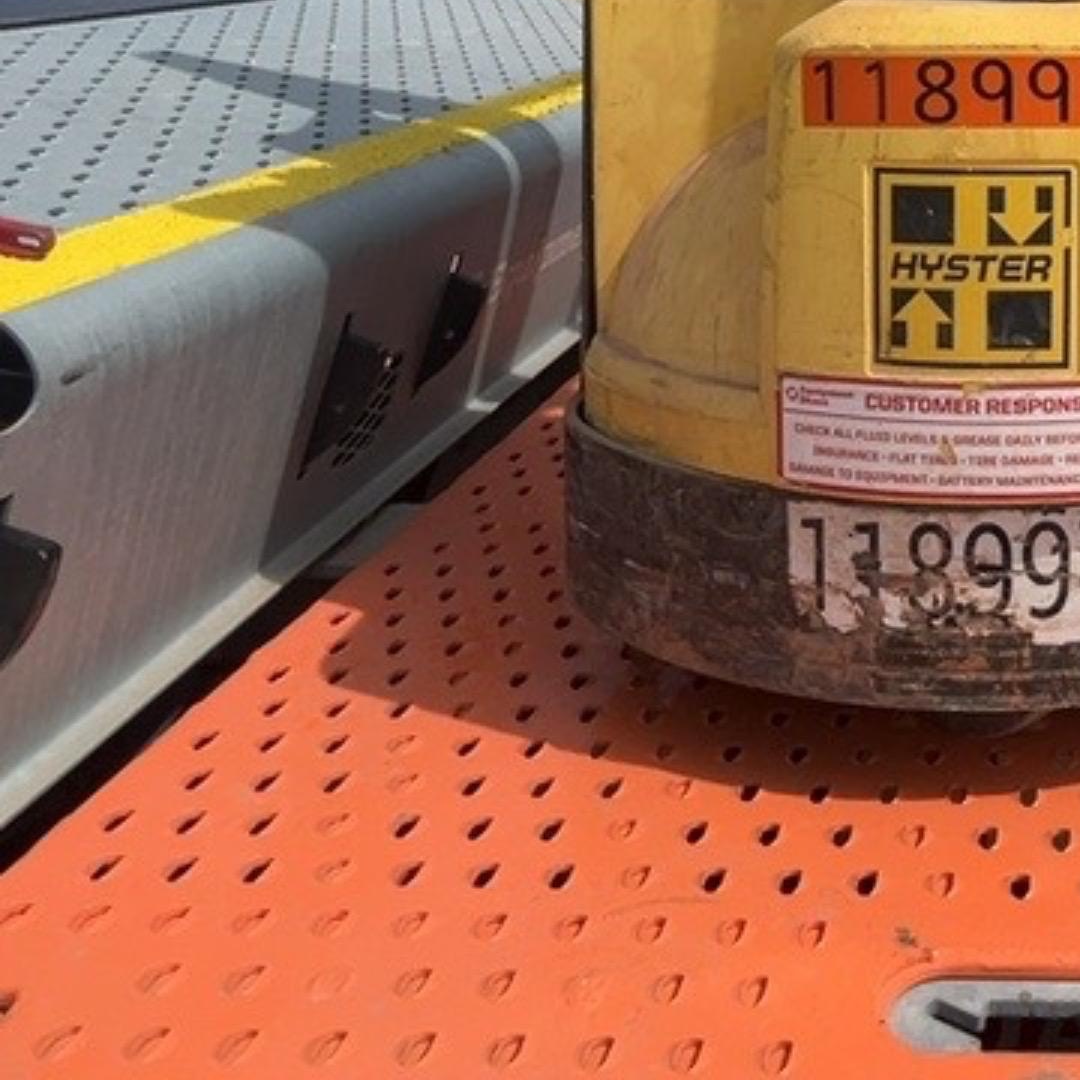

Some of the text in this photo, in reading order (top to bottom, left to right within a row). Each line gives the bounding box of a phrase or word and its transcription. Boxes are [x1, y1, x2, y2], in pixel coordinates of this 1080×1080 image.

[891, 252, 1053, 283] HYSTER
[864, 392, 980, 415] CUSTOMER
[794, 423, 830, 436] CHECK
